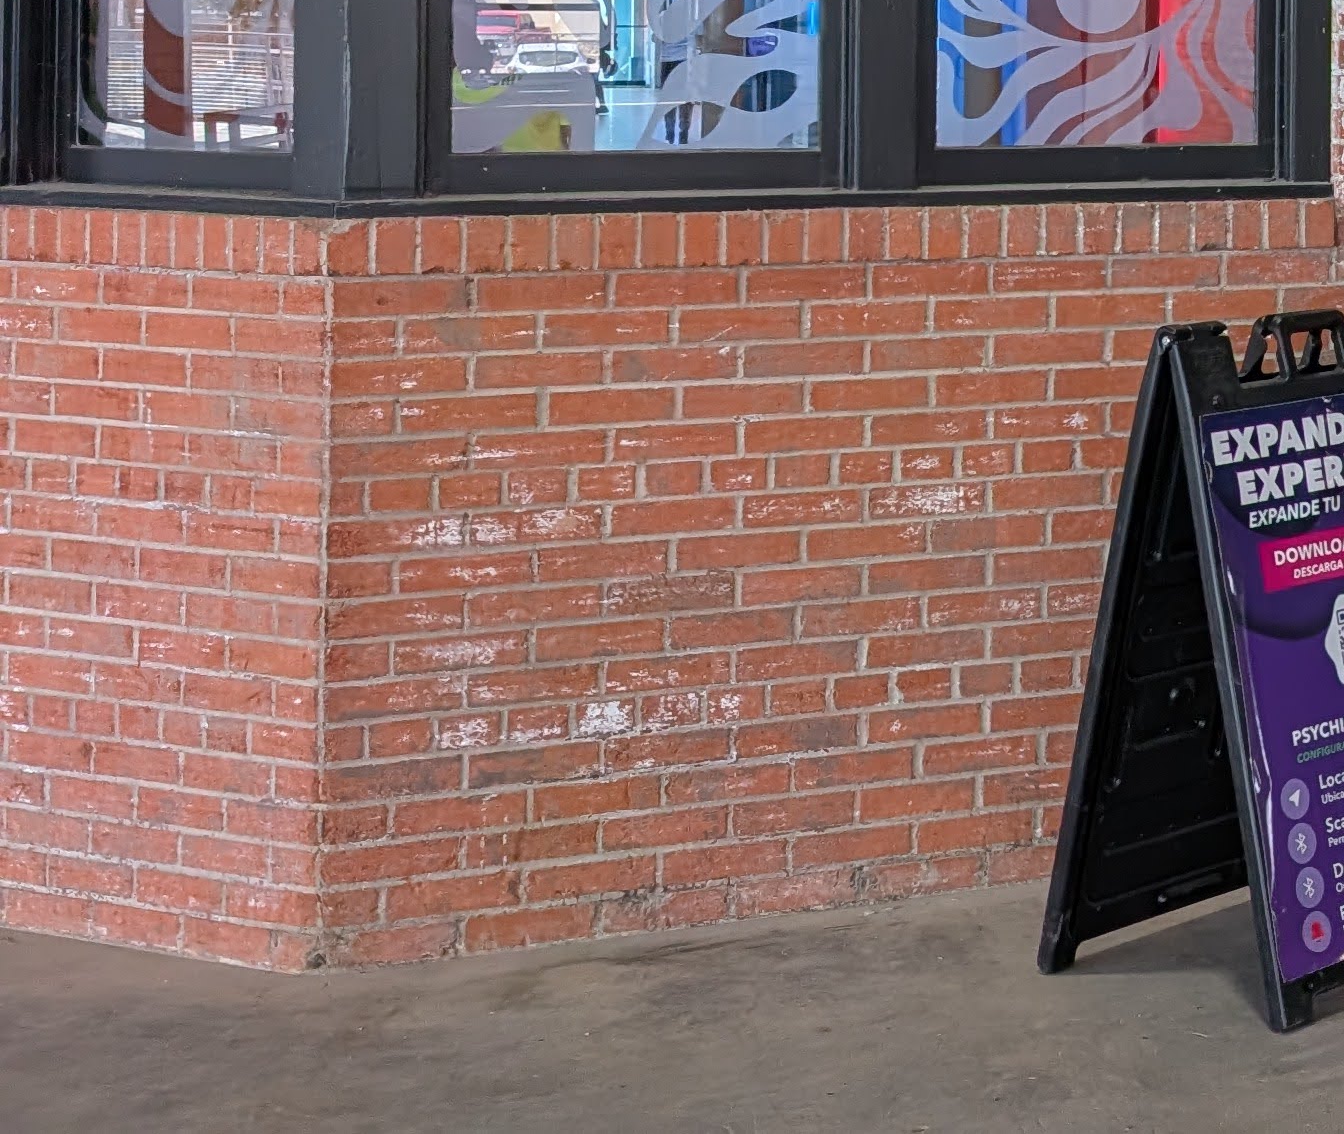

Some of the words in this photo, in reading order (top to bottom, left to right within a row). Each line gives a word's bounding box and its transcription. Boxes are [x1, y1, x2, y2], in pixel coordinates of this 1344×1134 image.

[1249, 500, 1320, 528] EXPANDE
[1323, 495, 1341, 513] TU
[1293, 559, 1343, 579] DESCARGA
